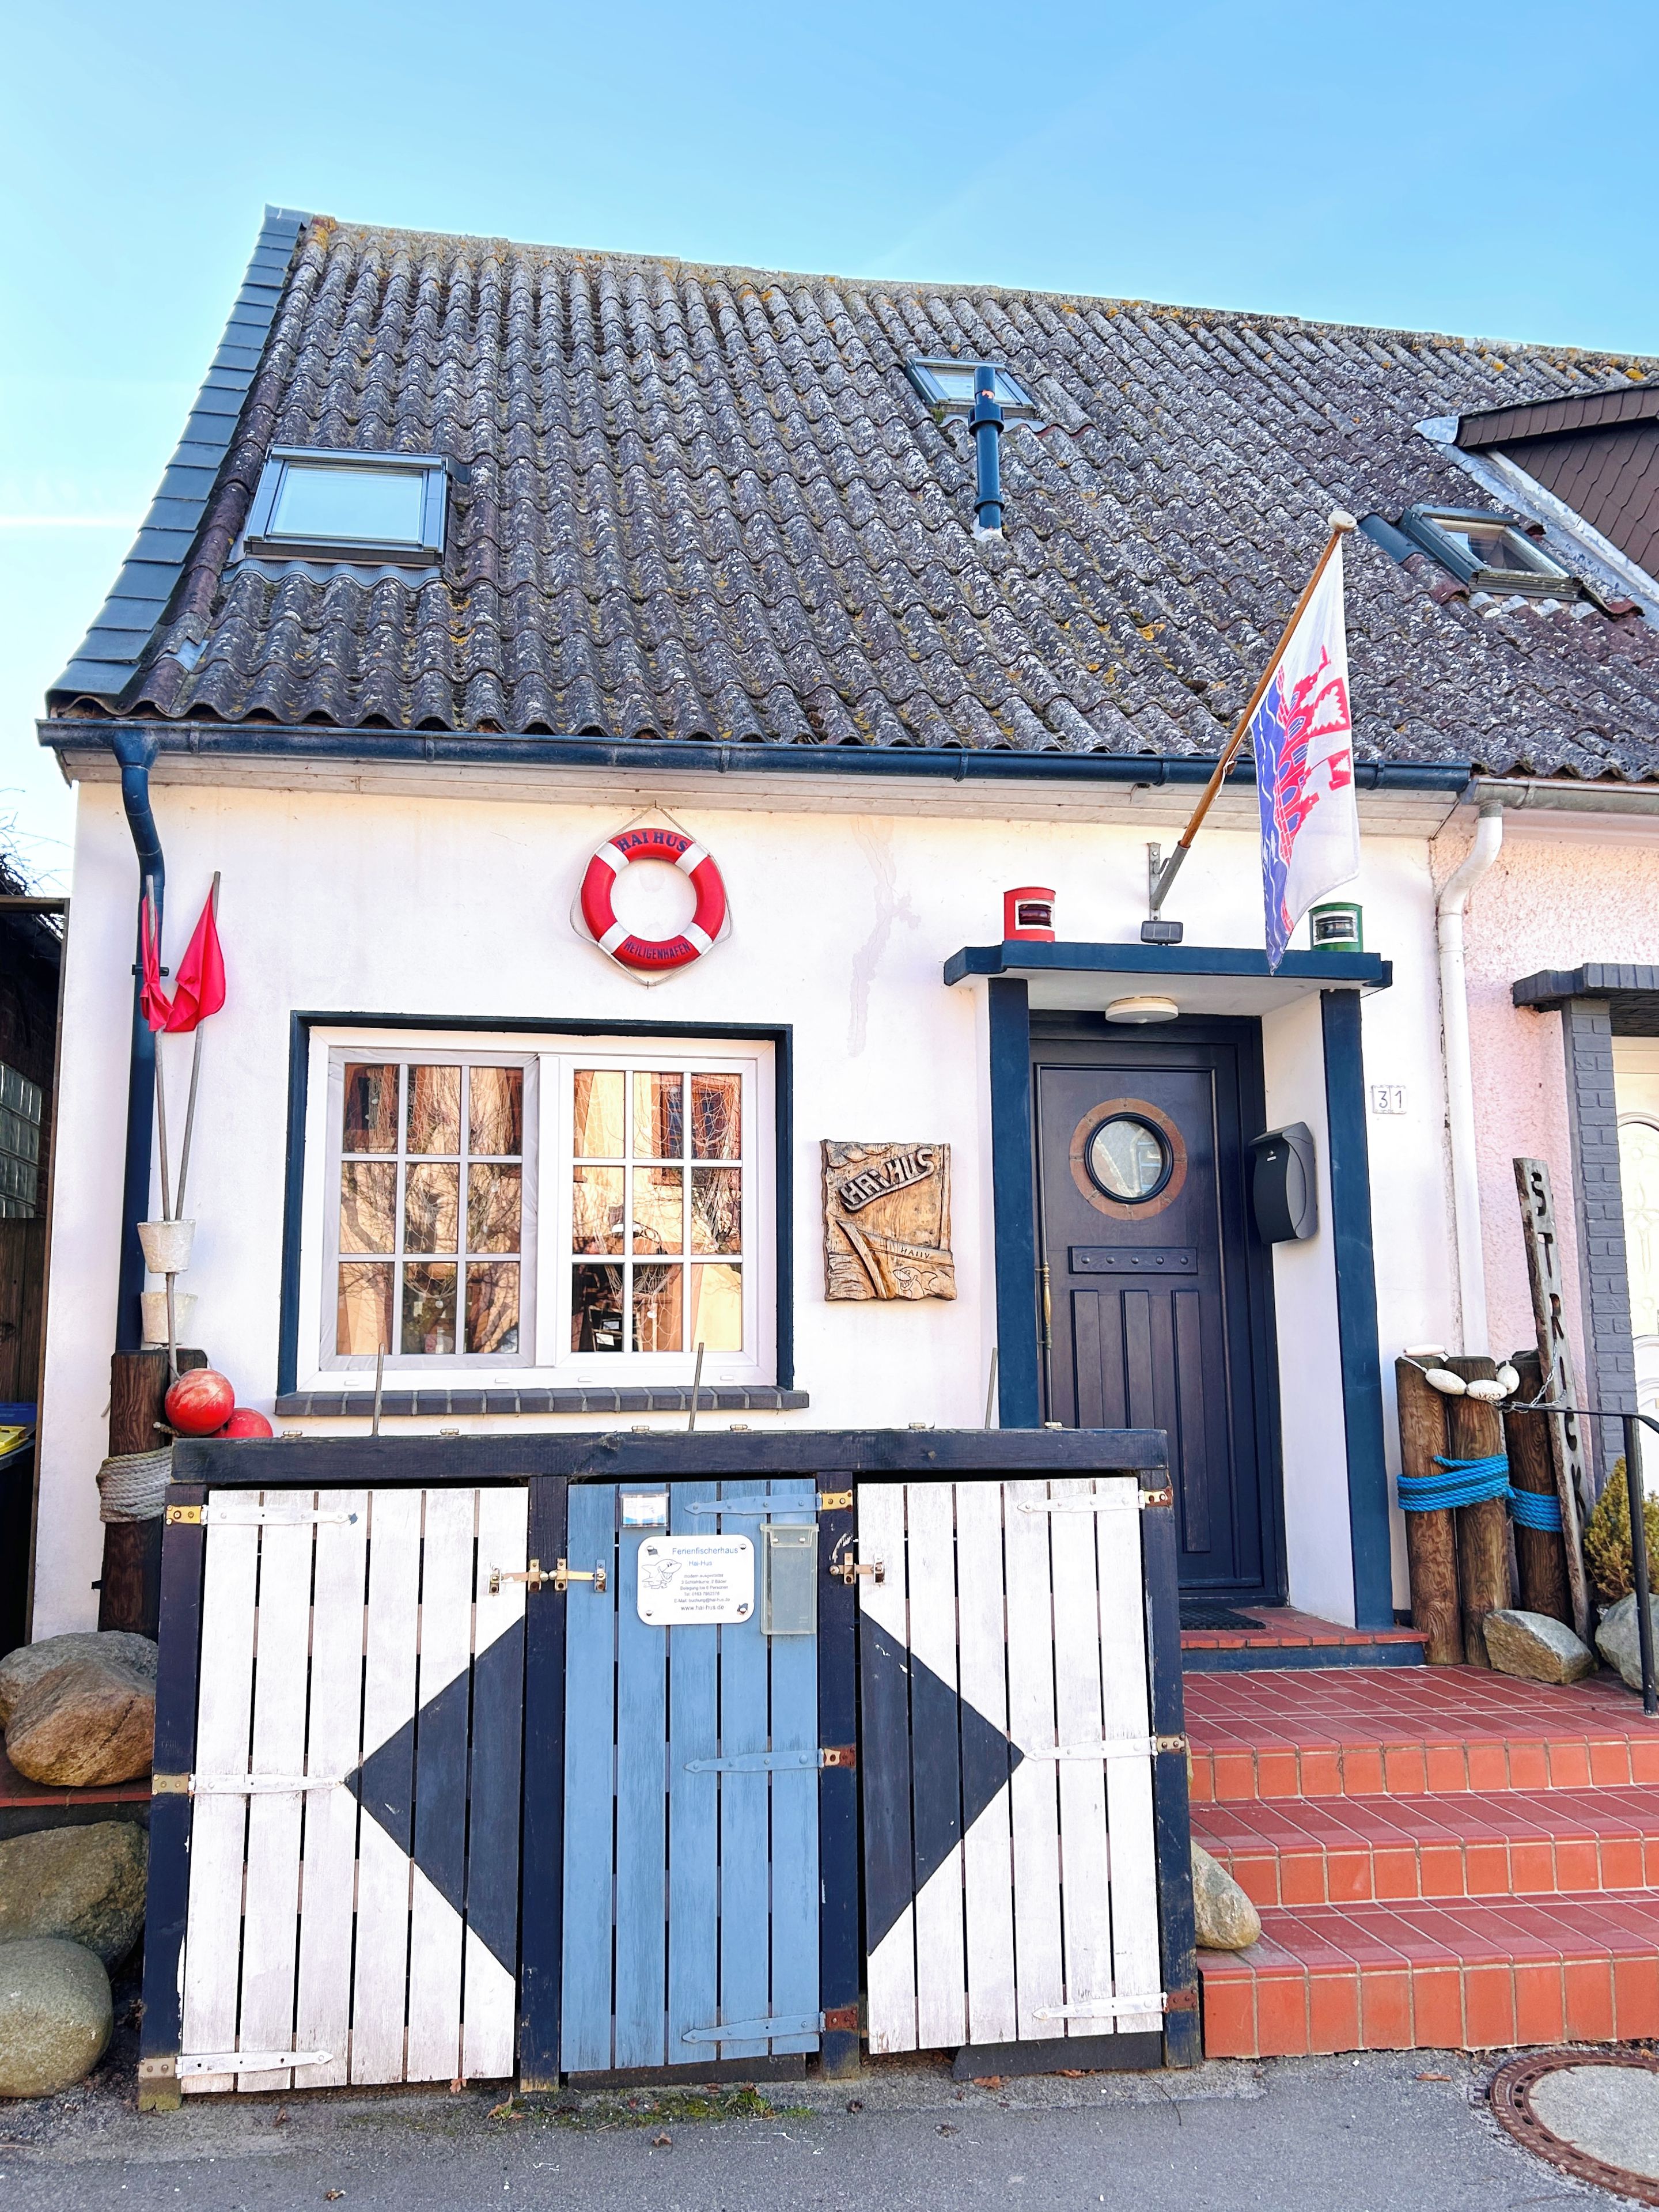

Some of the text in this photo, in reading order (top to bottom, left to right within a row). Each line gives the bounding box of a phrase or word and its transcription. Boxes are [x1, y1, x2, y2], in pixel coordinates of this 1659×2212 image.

[616, 831, 688, 853] HAI HUS
[624, 940, 690, 960] HEILIGENHAFEN
[1378, 1090, 1402, 1108] 31
[885, 1147, 934, 1184] HUS
[672, 1547, 738, 1555] Ferienfischerhaus
